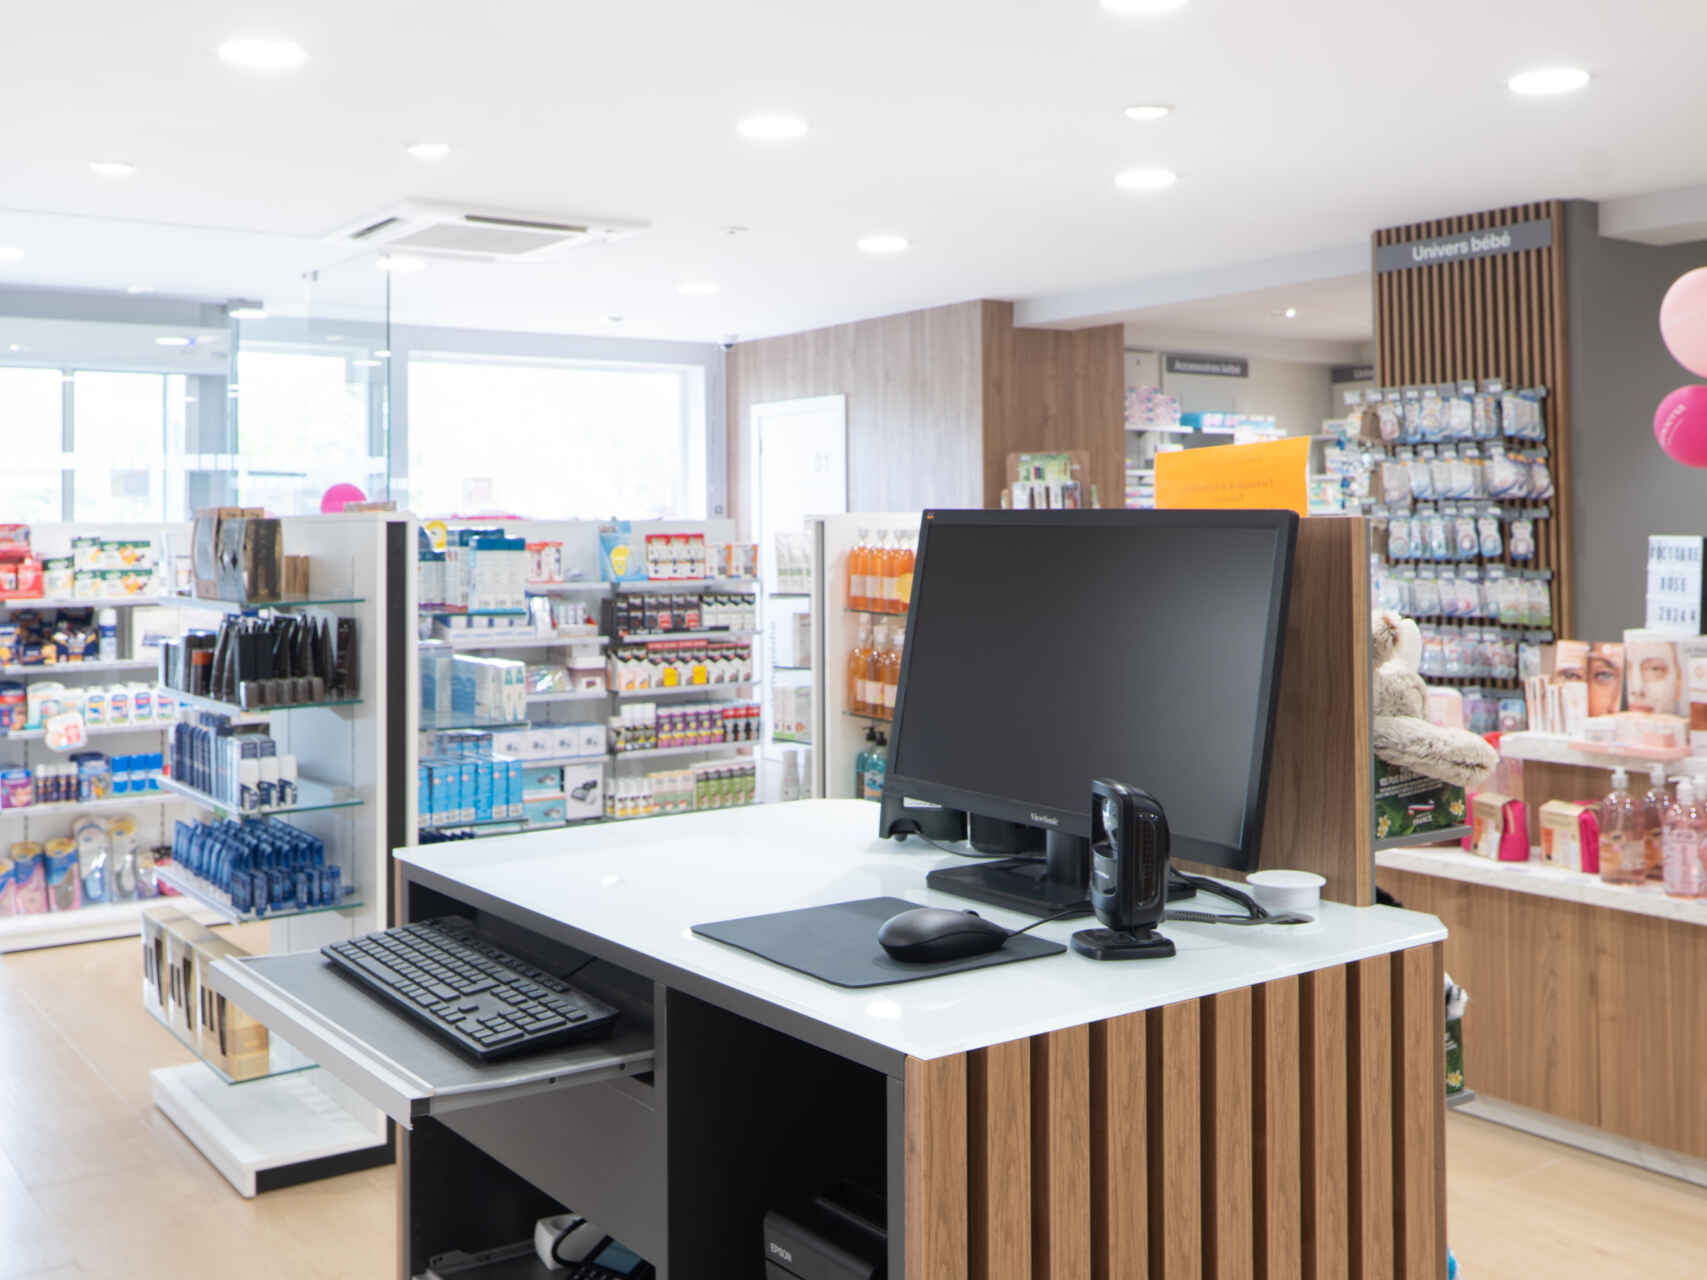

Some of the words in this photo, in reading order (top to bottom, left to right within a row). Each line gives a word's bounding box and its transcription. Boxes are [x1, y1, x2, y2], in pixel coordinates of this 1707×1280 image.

[1412, 241, 1469, 261] Univers
[1470, 231, 1511, 253] bébé
[769, 1242, 792, 1262] EPSON
